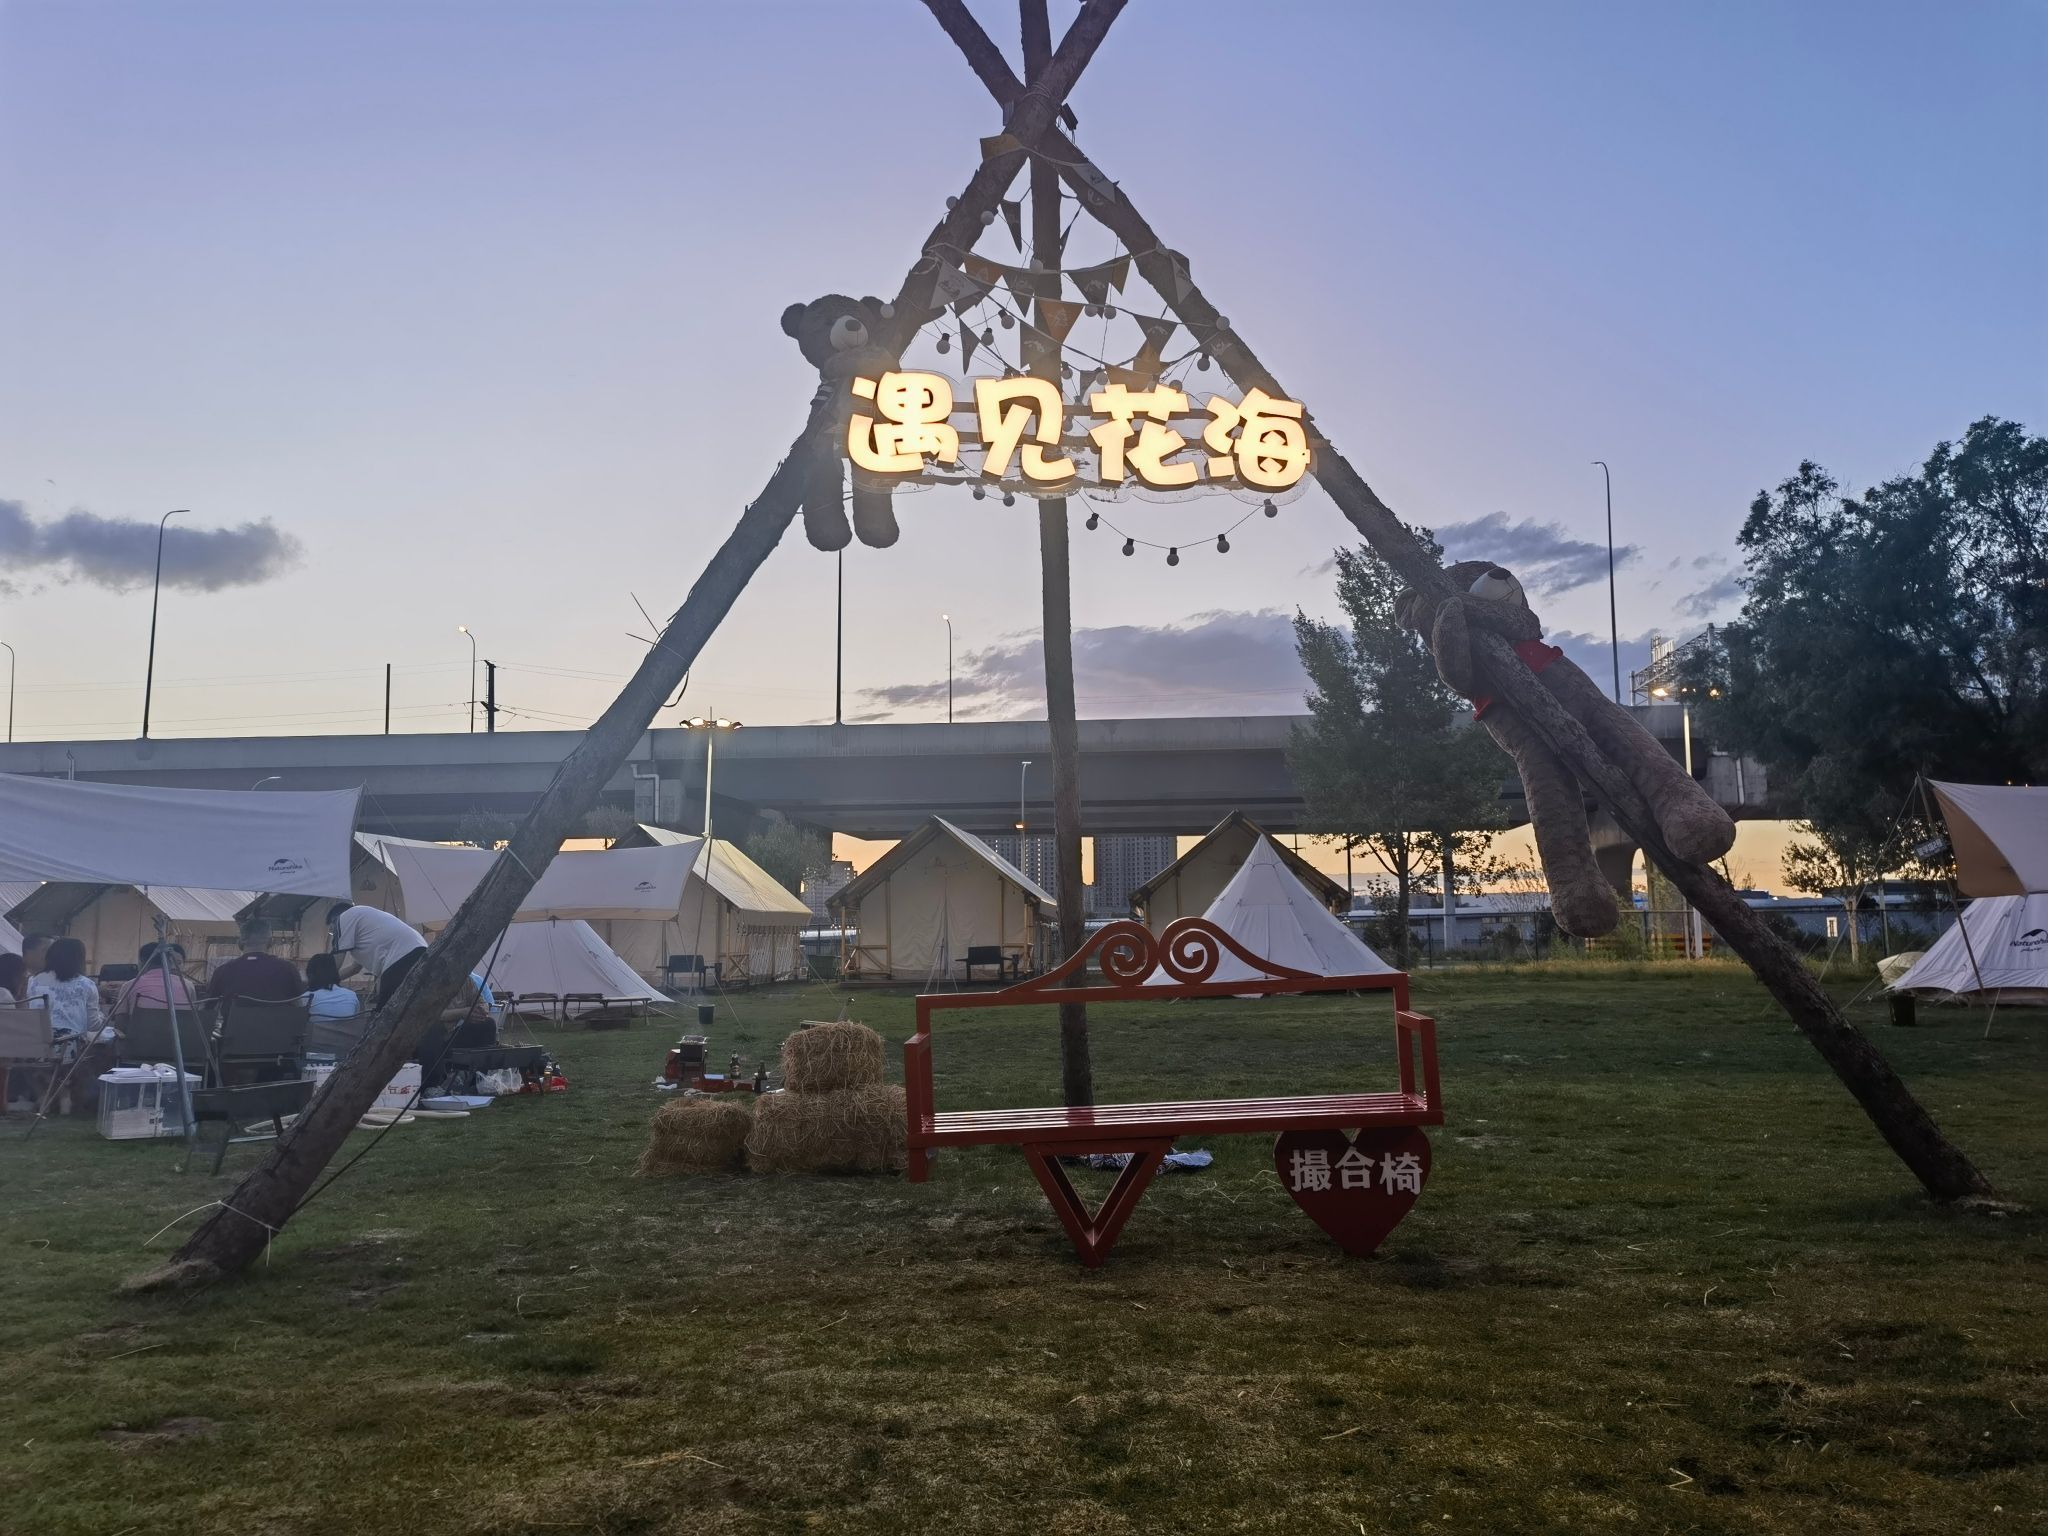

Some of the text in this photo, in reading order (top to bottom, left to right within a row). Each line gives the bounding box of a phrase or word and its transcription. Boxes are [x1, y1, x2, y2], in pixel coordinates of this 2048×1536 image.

[848, 371, 1311, 492] 遇见花海
[1289, 1146, 1424, 1196] 撮合椅
